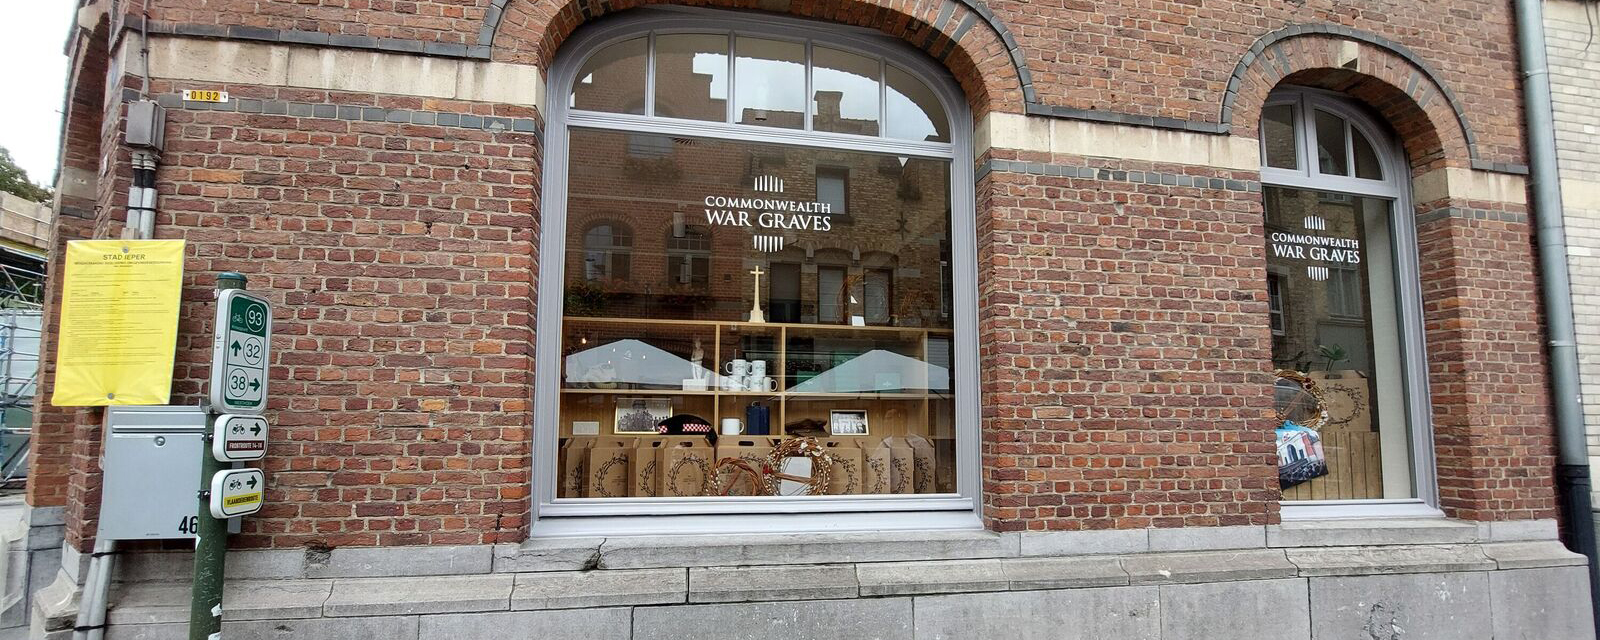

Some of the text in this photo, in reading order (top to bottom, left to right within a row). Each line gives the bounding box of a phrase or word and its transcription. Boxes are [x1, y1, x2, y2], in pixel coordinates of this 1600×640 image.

[191, 90, 219, 101] 0192
[704, 195, 832, 214] COMMONWEALTH
[704, 209, 832, 232] WAR GRAVES
[1271, 232, 1359, 249] COMMONWEALTH
[124, 253, 146, 261] IEPER
[1272, 243, 1360, 264] WAR GRAVES
[248, 310, 263, 326] 93
[245, 343, 261, 359] 32
[230, 375, 246, 391] 38
[178, 515, 199, 535] 46
